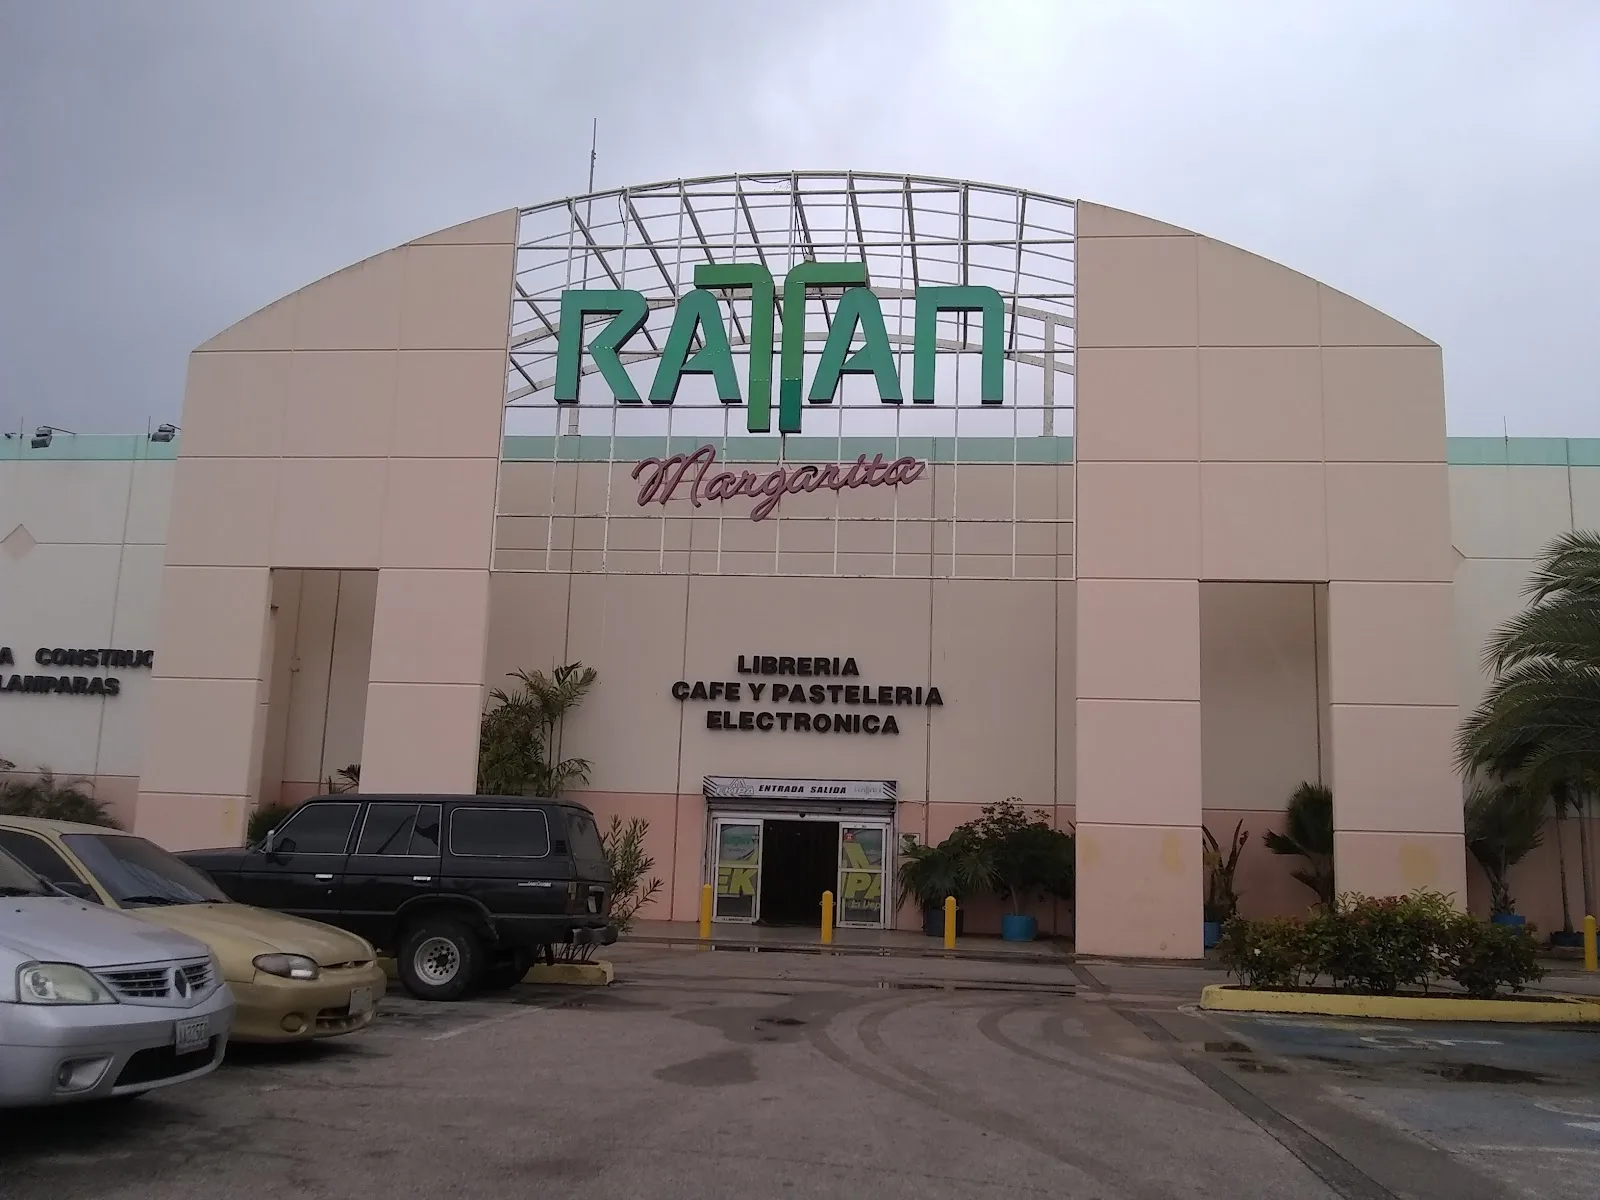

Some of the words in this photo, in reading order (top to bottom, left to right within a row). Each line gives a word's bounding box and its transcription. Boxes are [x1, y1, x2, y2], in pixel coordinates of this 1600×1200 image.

[554, 261, 1005, 434] RATTAN
[631, 444, 925, 522] Margarita
[737, 655, 859, 676] LIBRERIA
[672, 681, 741, 701] CAFE
[748, 683, 766, 701] Y
[772, 683, 944, 706] PASTELERIA
[706, 710, 900, 734] ELECTRONICA
[758, 784, 805, 793] ENTRADA
[810, 786, 847, 794] SALIDA
